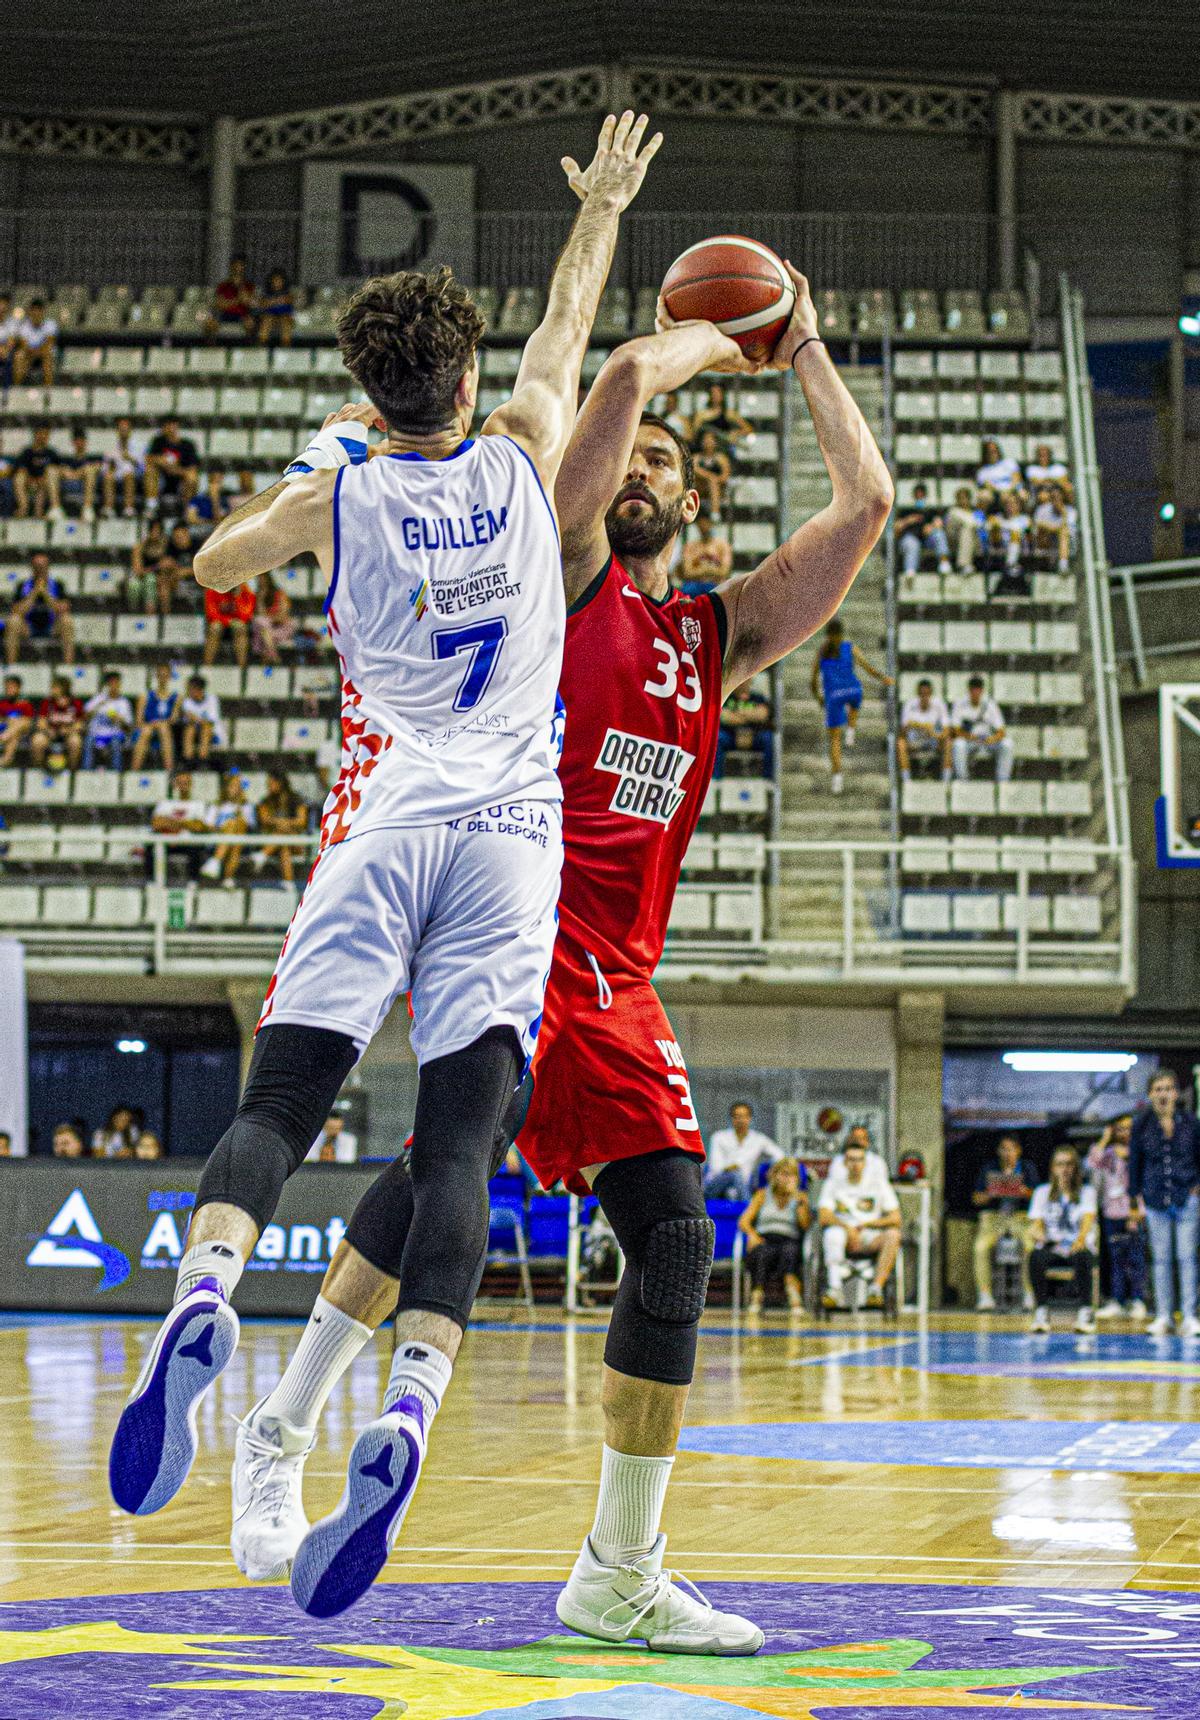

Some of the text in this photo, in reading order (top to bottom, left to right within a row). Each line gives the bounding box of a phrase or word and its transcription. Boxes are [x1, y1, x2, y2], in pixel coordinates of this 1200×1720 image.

[340, 173, 435, 276] D
[402, 503, 507, 550] GUILLÉM
[432, 571, 508, 602] OMUNITAT
[458, 582, 521, 611] L'ESPORT
[431, 616, 508, 712] 7
[644, 637, 702, 713] 33
[467, 821, 493, 832] DEL
[498, 822, 548, 848] DEPORTE
